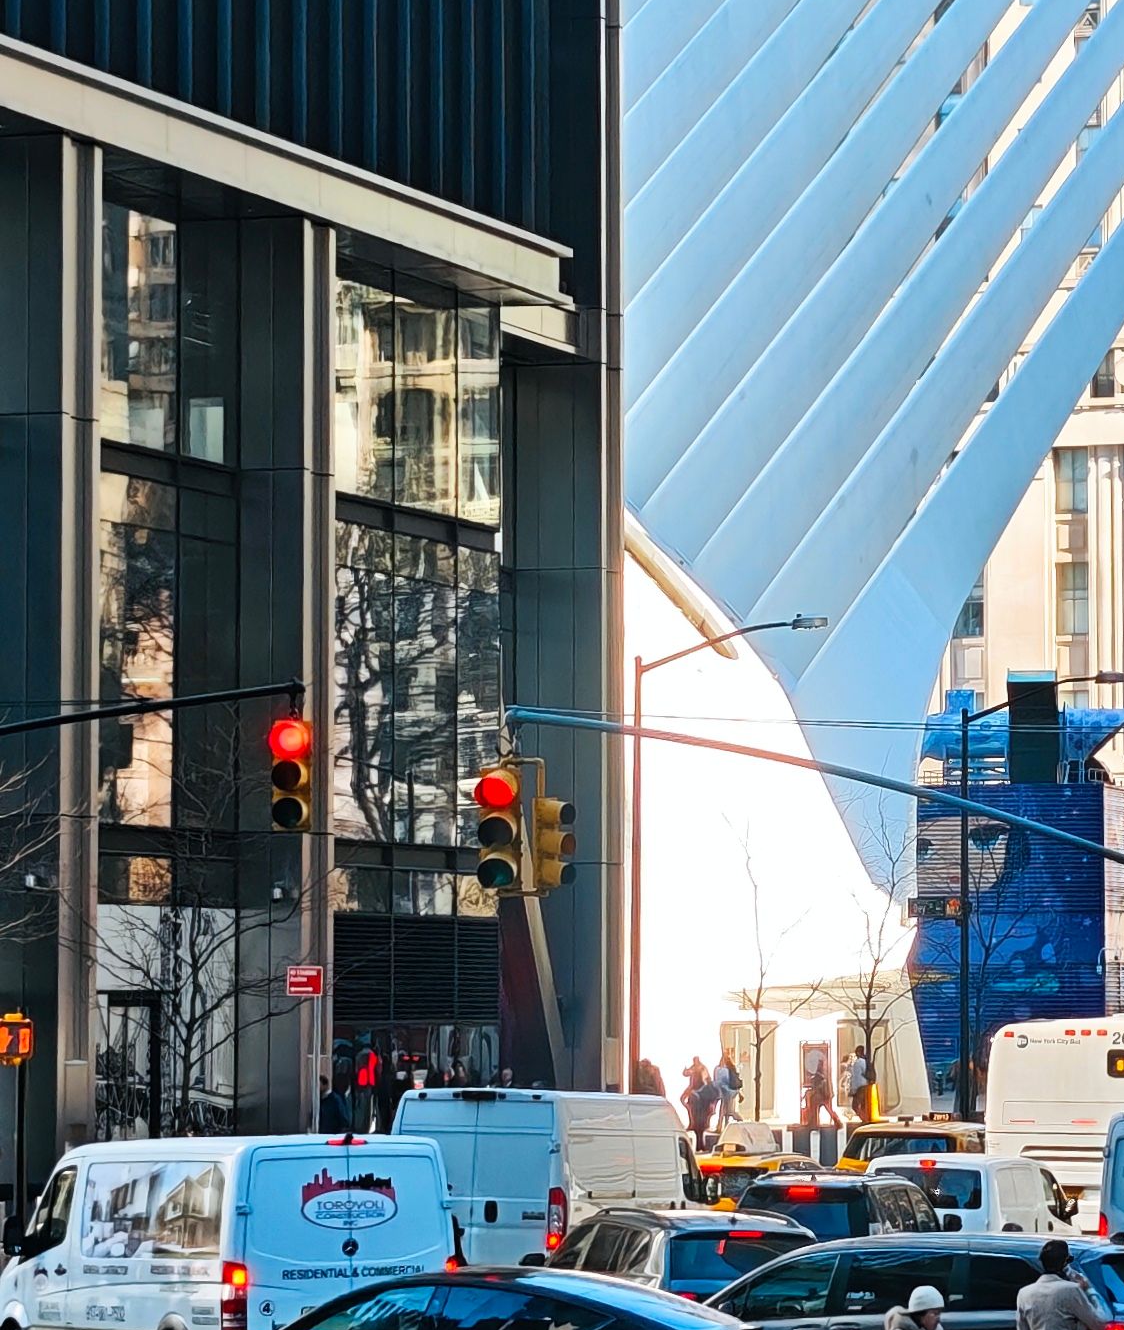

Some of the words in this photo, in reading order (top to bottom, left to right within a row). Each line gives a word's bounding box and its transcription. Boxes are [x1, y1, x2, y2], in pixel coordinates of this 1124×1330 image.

[282, 1269, 349, 1280] RESIDENTIAL
[350, 1268, 359, 1278] &
[361, 1265, 425, 1277] COMMERCIAL
[262, 1302, 271, 1314] 4
